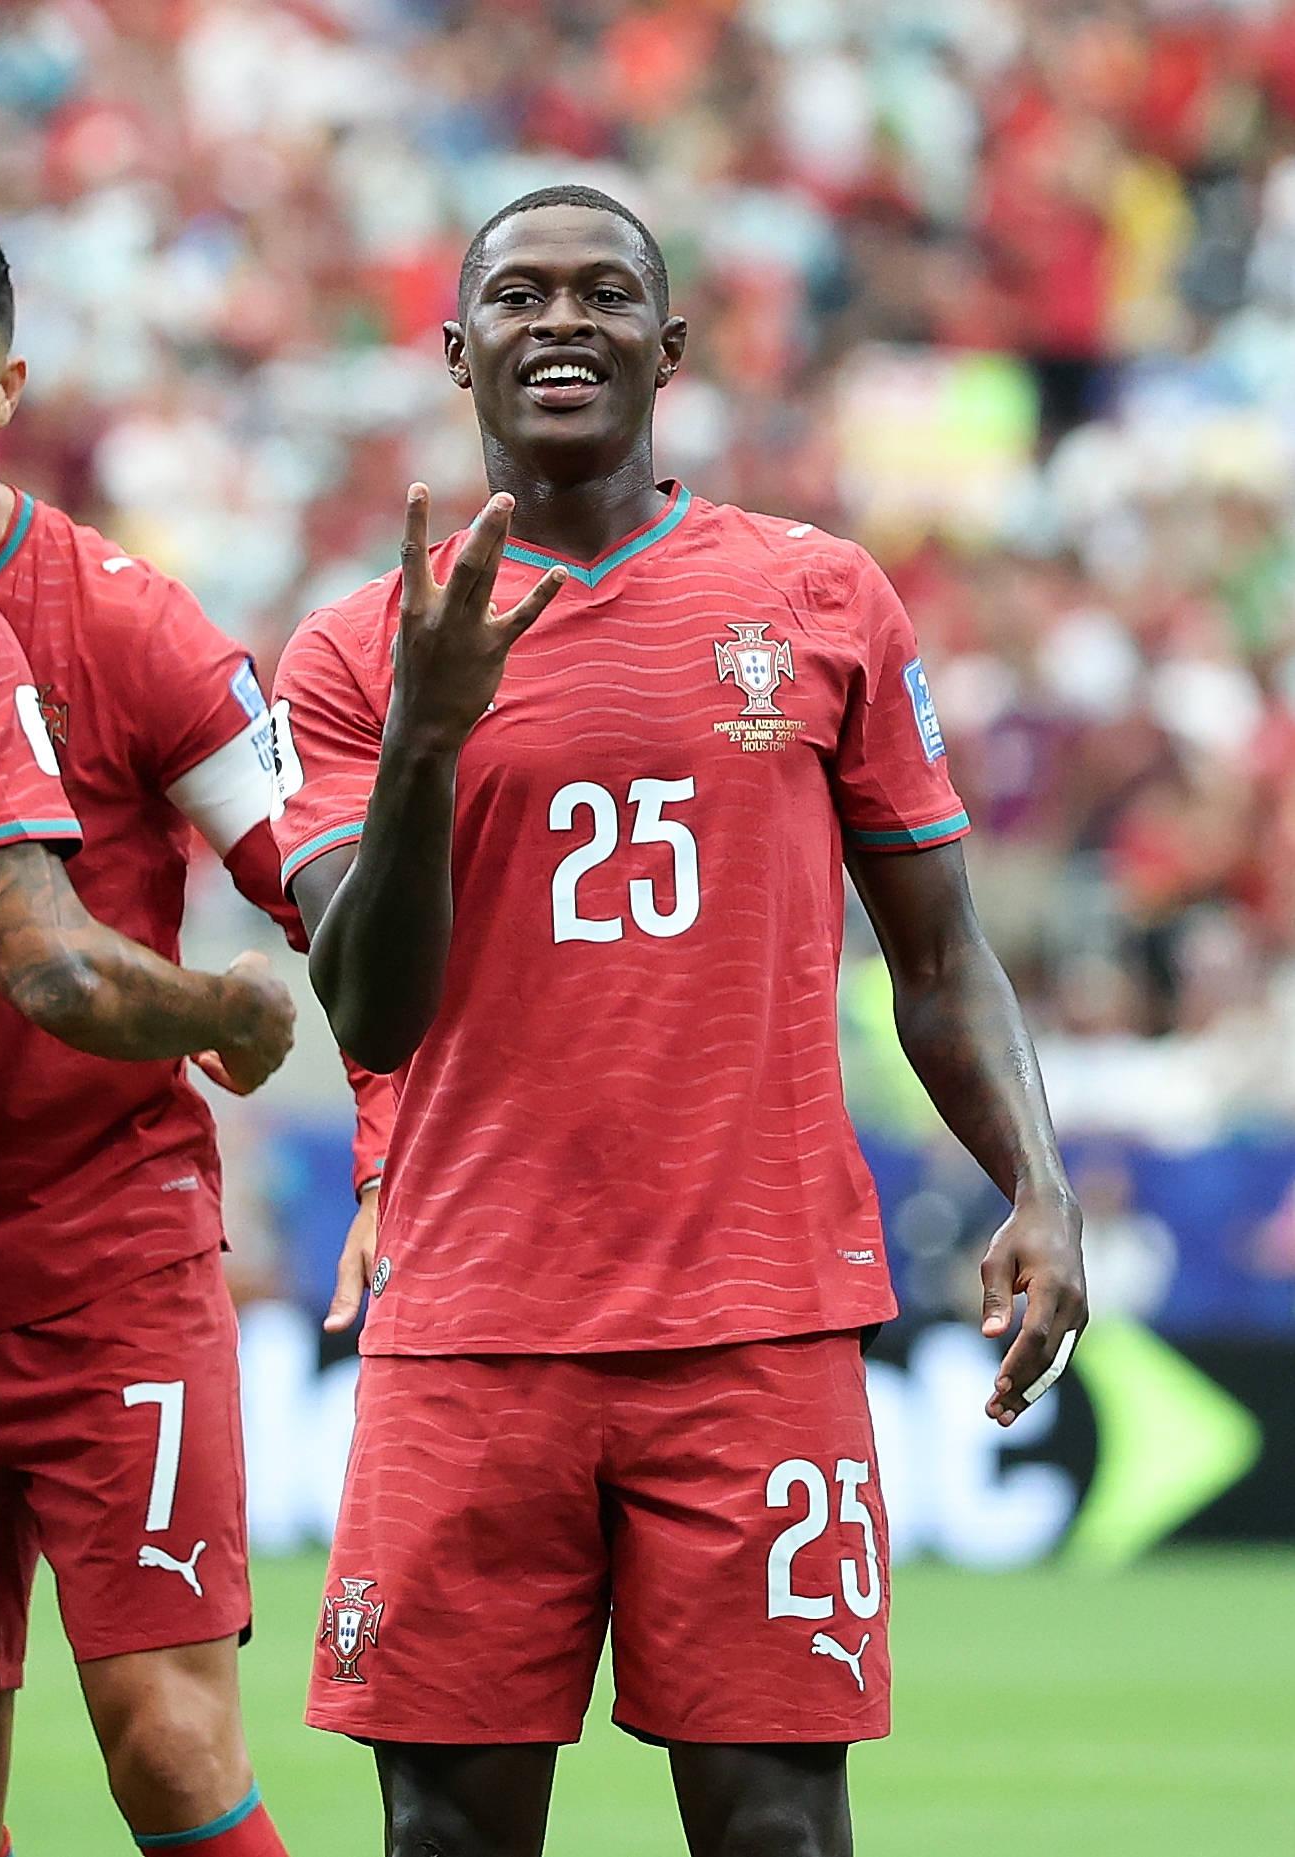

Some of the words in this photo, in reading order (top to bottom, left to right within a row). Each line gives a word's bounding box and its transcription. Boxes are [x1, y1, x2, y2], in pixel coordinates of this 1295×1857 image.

[728, 731, 741, 742] 23
[743, 730, 773, 741] JUNHO
[741, 741, 786, 752] HOUSTON
[548, 776, 700, 943] 25
[122, 1379, 186, 1533] 7
[766, 1458, 881, 1620] 25
